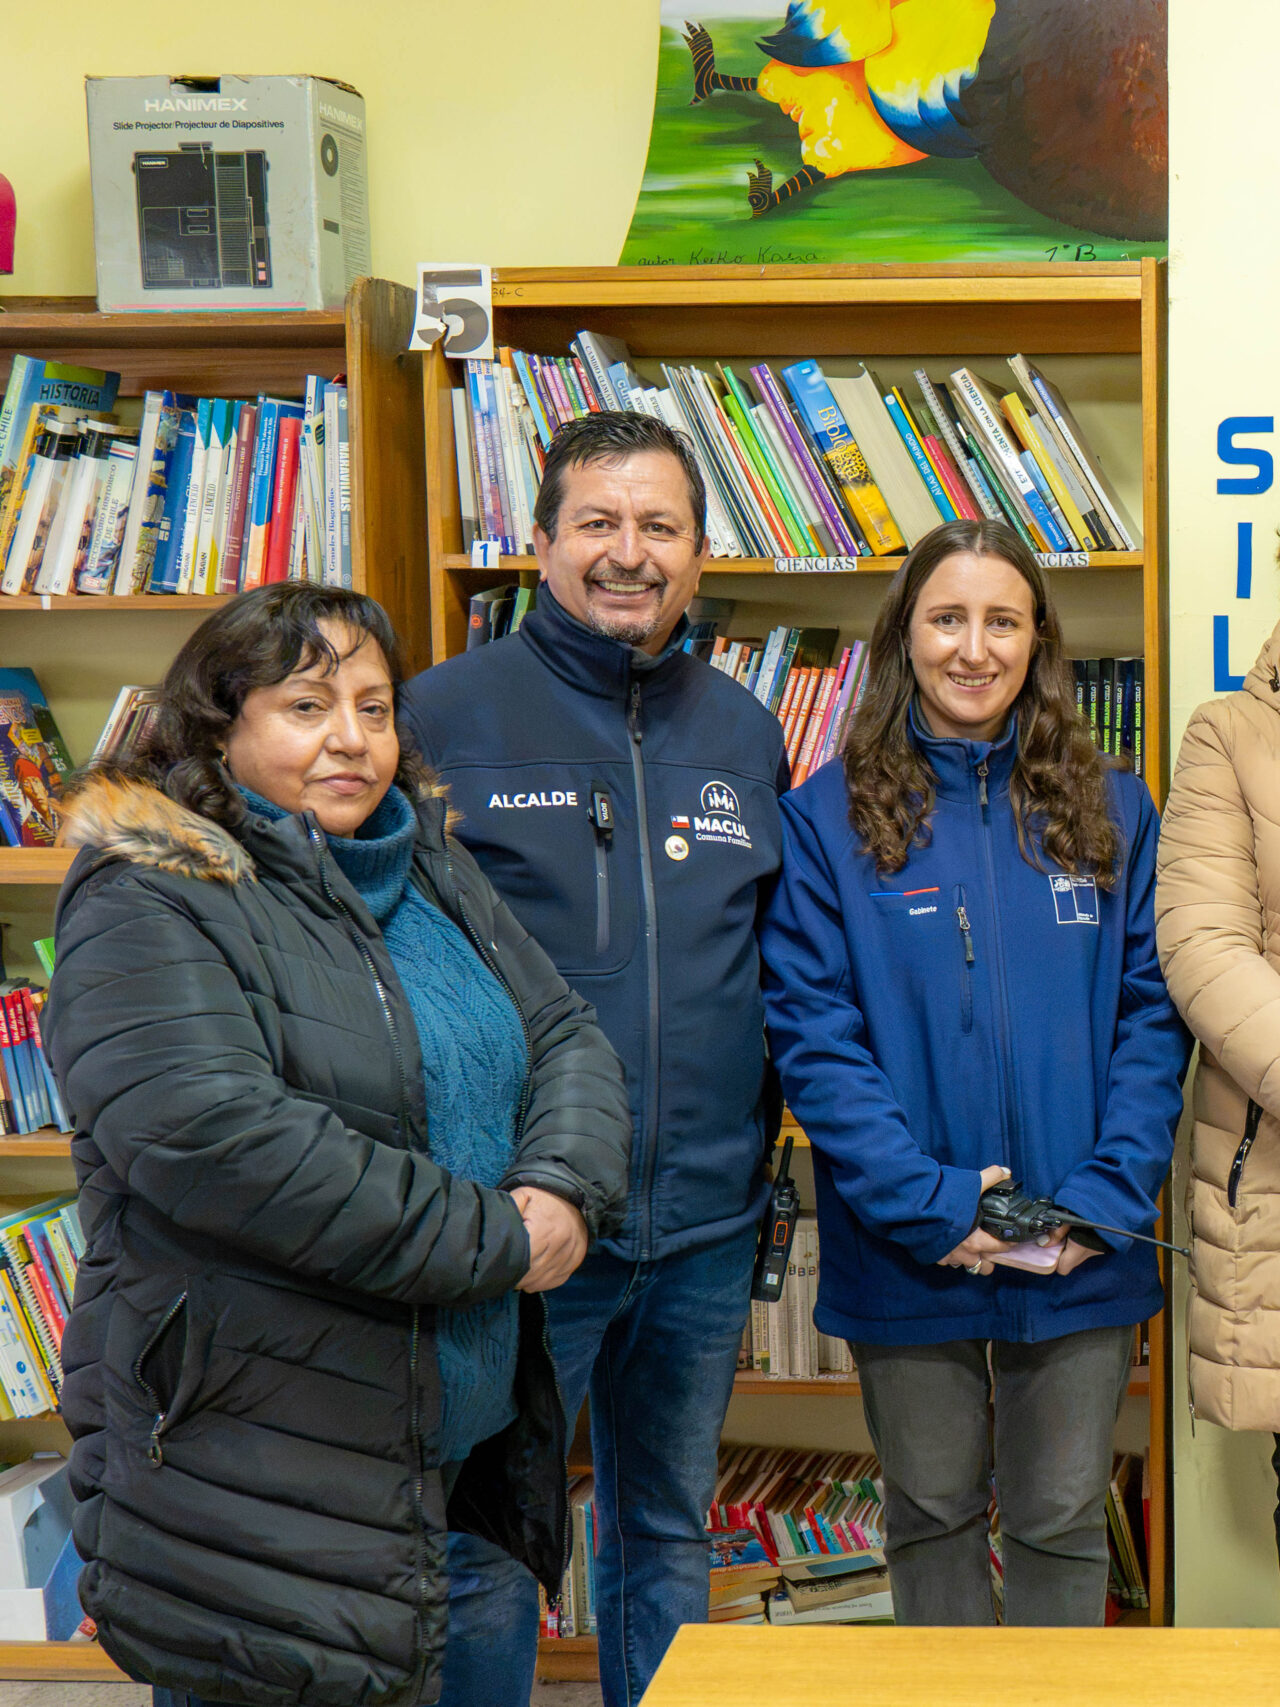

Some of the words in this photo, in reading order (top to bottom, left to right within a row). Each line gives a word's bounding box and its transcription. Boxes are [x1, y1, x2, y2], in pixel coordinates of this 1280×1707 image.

[144, 98, 249, 113] HANIMEX
[319, 102, 363, 130] HANIMEX
[113, 121, 133, 130] Slide
[219, 121, 230, 129] de
[232, 119, 285, 130] Diapositives
[1074, 243, 1098, 262] B
[417, 268, 489, 354] 5
[585, 345, 601, 374] CAMBIO
[40, 384, 100, 405] HISTORIA
[961, 373, 985, 409] CIENCIA
[979, 407, 988, 418] LA
[984, 416, 995, 429] CON
[817, 405, 860, 482] Biología
[905, 433, 921, 460] MUNDO
[339, 442, 351, 512] MARAVILLAS
[920, 460, 931, 474] DEL
[927, 474, 942, 497] ATLAS
[108, 497, 120, 525] CHILE
[479, 543, 490, 567] 1
[776, 558, 857, 572] CIENCIAS
[489, 791, 578, 808] ALCALDE
[693, 817, 750, 840] MACUL
[695, 833, 726, 843] Comuna
[909, 906, 937, 916] Gabinete
